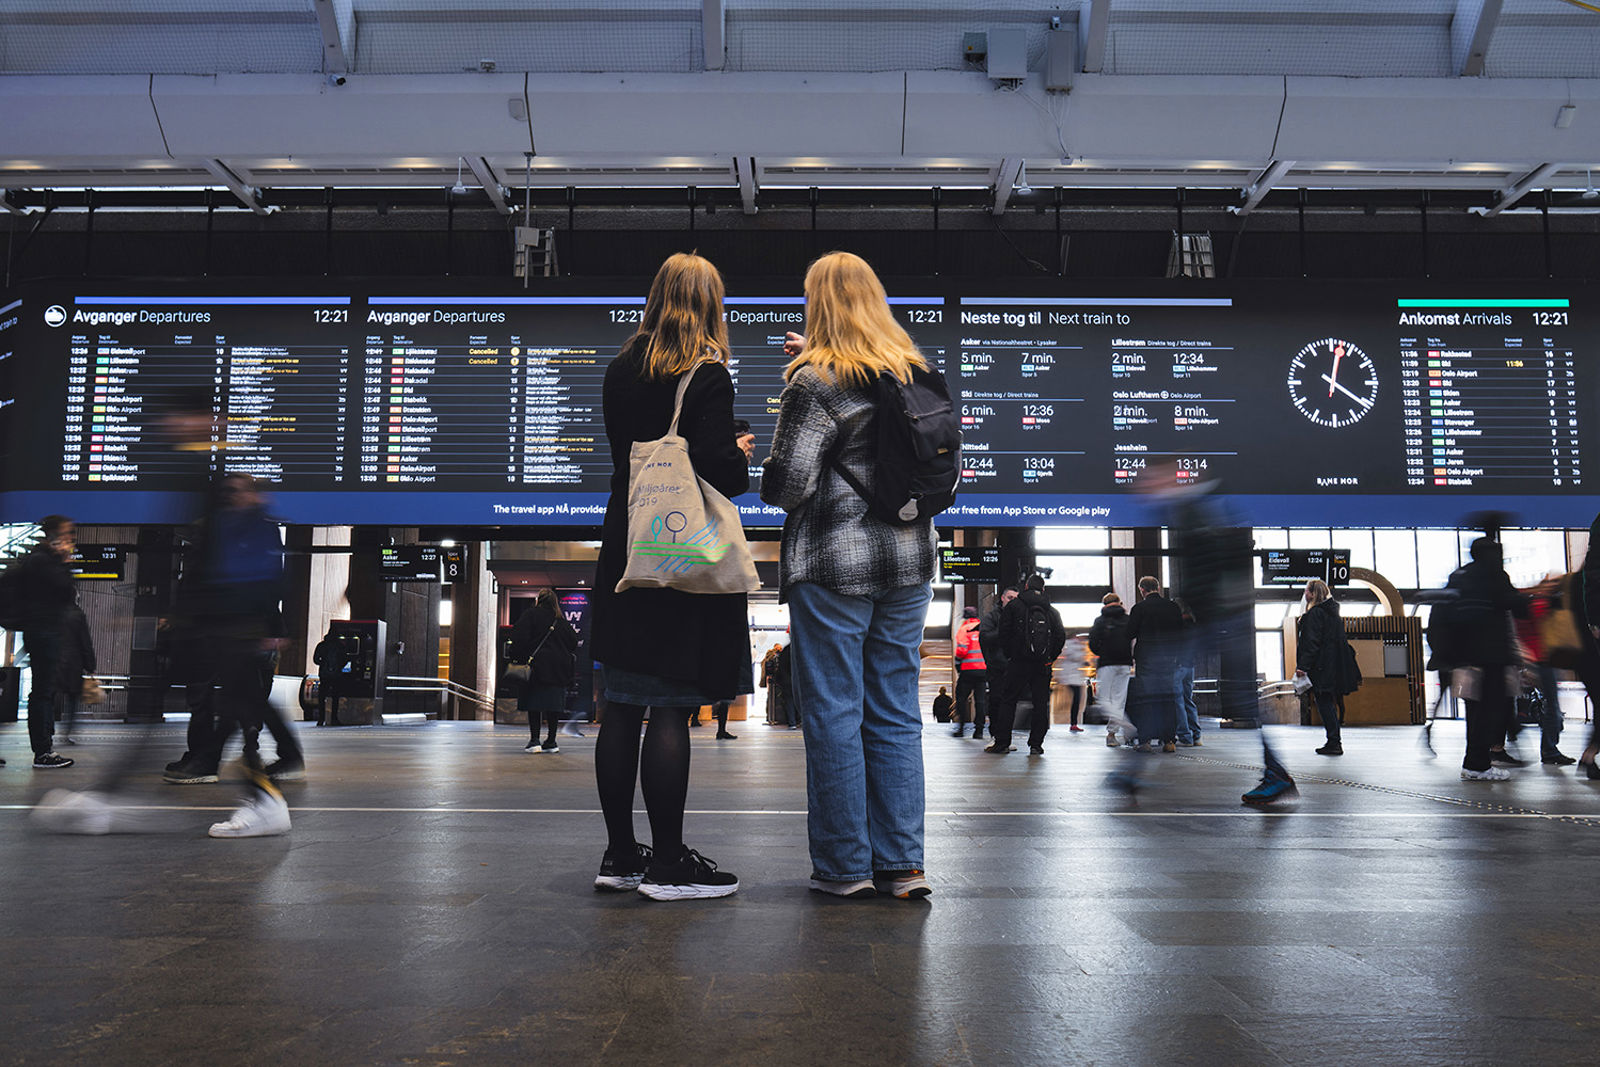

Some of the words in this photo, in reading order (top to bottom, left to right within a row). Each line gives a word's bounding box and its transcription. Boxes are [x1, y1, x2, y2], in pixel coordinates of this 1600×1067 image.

[73, 311, 137, 325] Avganger
[140, 310, 210, 324] Departures
[314, 310, 347, 322] 12:21
[367, 311, 431, 325] Avganger
[434, 310, 505, 324] Departures
[610, 310, 645, 323] 12:21
[731, 310, 802, 324] Departures
[908, 310, 942, 322] 12:21
[961, 312, 1000, 324] Neste
[1003, 313, 1025, 327] tog
[1028, 312, 1041, 324] til
[1049, 313, 1079, 324] Next
[1083, 313, 1112, 324] train
[1117, 313, 1130, 324] to
[1399, 312, 1460, 325] Ankomst
[1463, 313, 1512, 325] Arrivals
[1533, 312, 1568, 325] 12:21
[961, 352, 968, 363] 5
[971, 353, 995, 363] min.
[1022, 353, 1029, 363] 7
[1032, 353, 1055, 363] min.
[1112, 353, 1120, 363] 2
[1123, 353, 1146, 363] min.
[1174, 353, 1204, 364] 12:34
[962, 405, 969, 415] 6
[972, 405, 995, 415] min.
[1023, 405, 1054, 416] 12:36
[1175, 406, 1182, 416] 8
[1185, 406, 1208, 416] min.
[1114, 444, 1149, 453] Jessheim
[961, 458, 993, 468] 12:44
[1024, 458, 1055, 468] 13:04
[1116, 458, 1146, 469] 12:44
[1177, 459, 1207, 469] 13:14
[493, 504, 510, 513] The
[511, 505, 536, 513] travel
[537, 506, 555, 515] app
[556, 503, 569, 513] NÅ
[740, 505, 761, 514] train
[962, 505, 979, 514] free
[980, 506, 1002, 514] from
[1003, 506, 1022, 516] App
[1023, 506, 1046, 514] Store
[1059, 506, 1090, 516] Google
[1091, 506, 1110, 516] play
[450, 564, 457, 576] 8
[1332, 567, 1347, 579] 10
